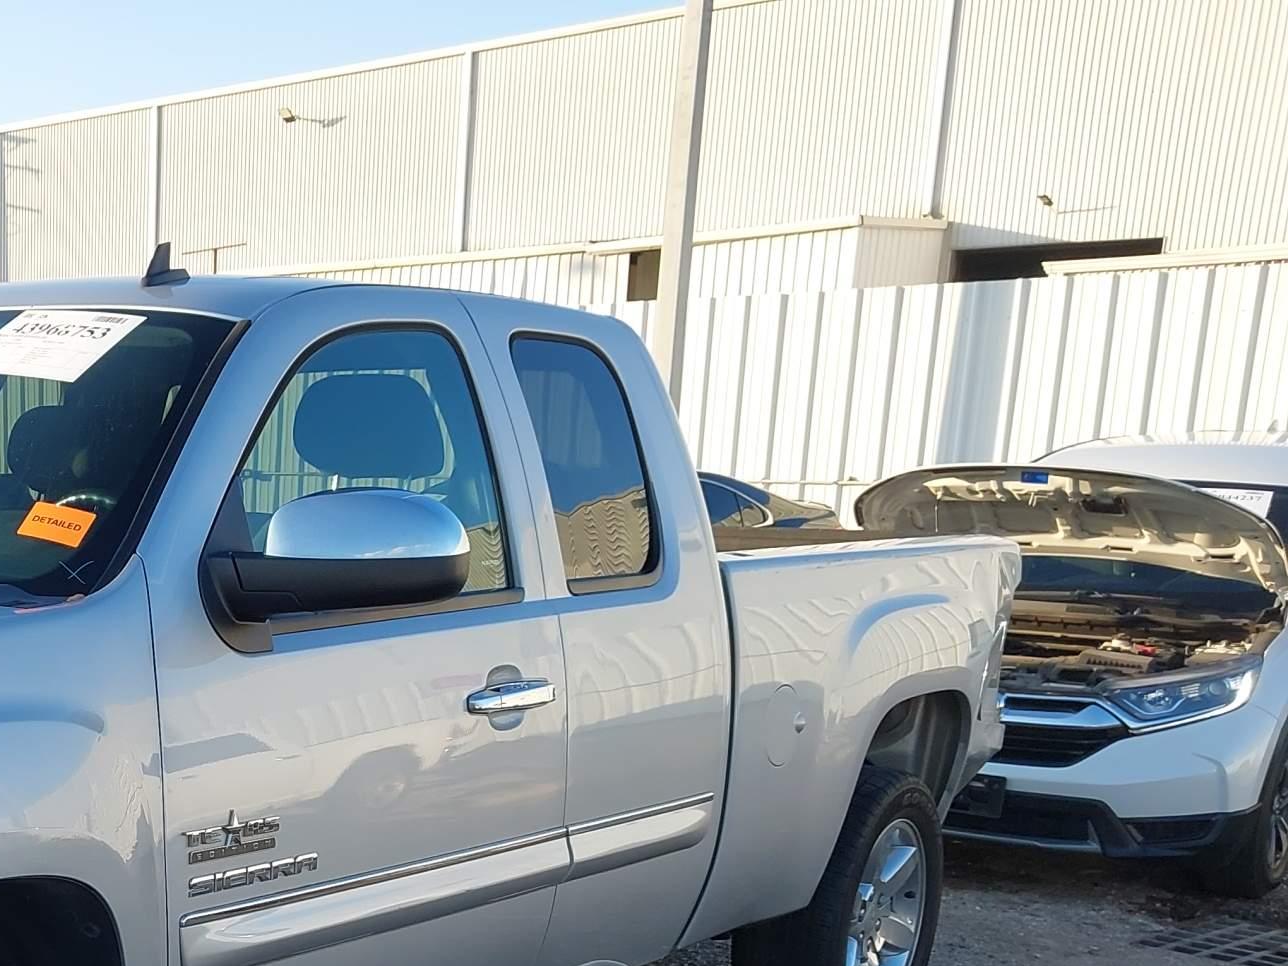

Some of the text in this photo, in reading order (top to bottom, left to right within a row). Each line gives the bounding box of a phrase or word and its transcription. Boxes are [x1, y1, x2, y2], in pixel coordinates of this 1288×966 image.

[12, 322, 112, 339] 43968753
[32, 515, 82, 532] DETAILED
[188, 852, 319, 898] SIERRA
